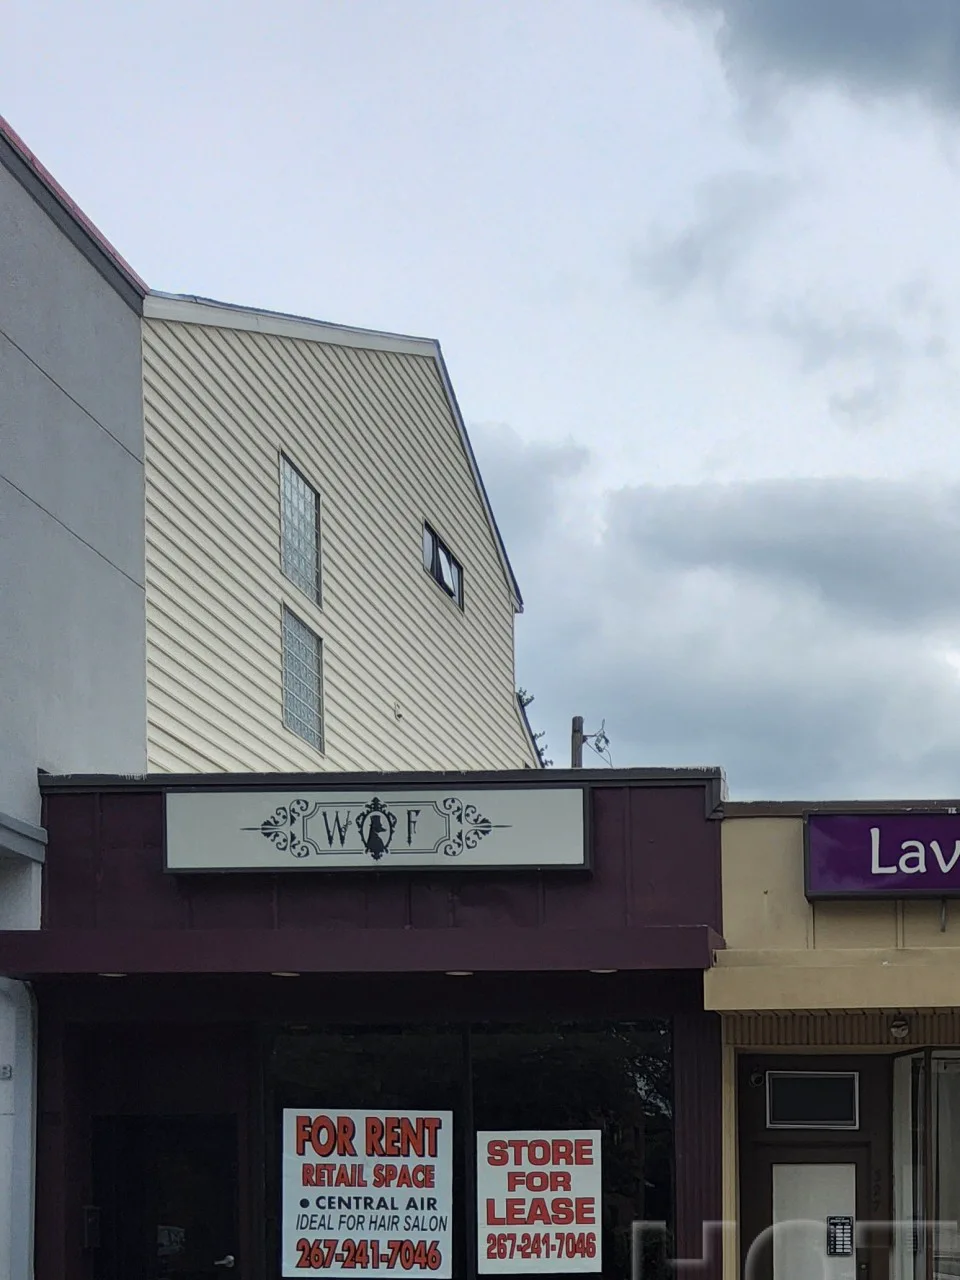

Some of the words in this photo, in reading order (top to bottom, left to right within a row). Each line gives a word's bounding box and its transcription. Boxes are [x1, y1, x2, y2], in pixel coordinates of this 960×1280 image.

[295, 1115, 358, 1157] FOR
[365, 1116, 443, 1158] RENT
[487, 1138, 594, 1166] STORE
[302, 1163, 368, 1188] RETAIL
[372, 1164, 436, 1189] SPACE
[507, 1171, 572, 1192] FOR
[315, 1196, 399, 1211] CENTRAL
[405, 1197, 438, 1211] AIR
[486, 1197, 596, 1226] LEASE
[296, 1214, 335, 1231] IDEAL
[338, 1214, 366, 1231] FOR
[368, 1215, 401, 1232] HAIR
[403, 1216, 448, 1232] SALON
[295, 1237, 443, 1270] 267-241-7046
[487, 1232, 597, 1259] 267-241-7046
